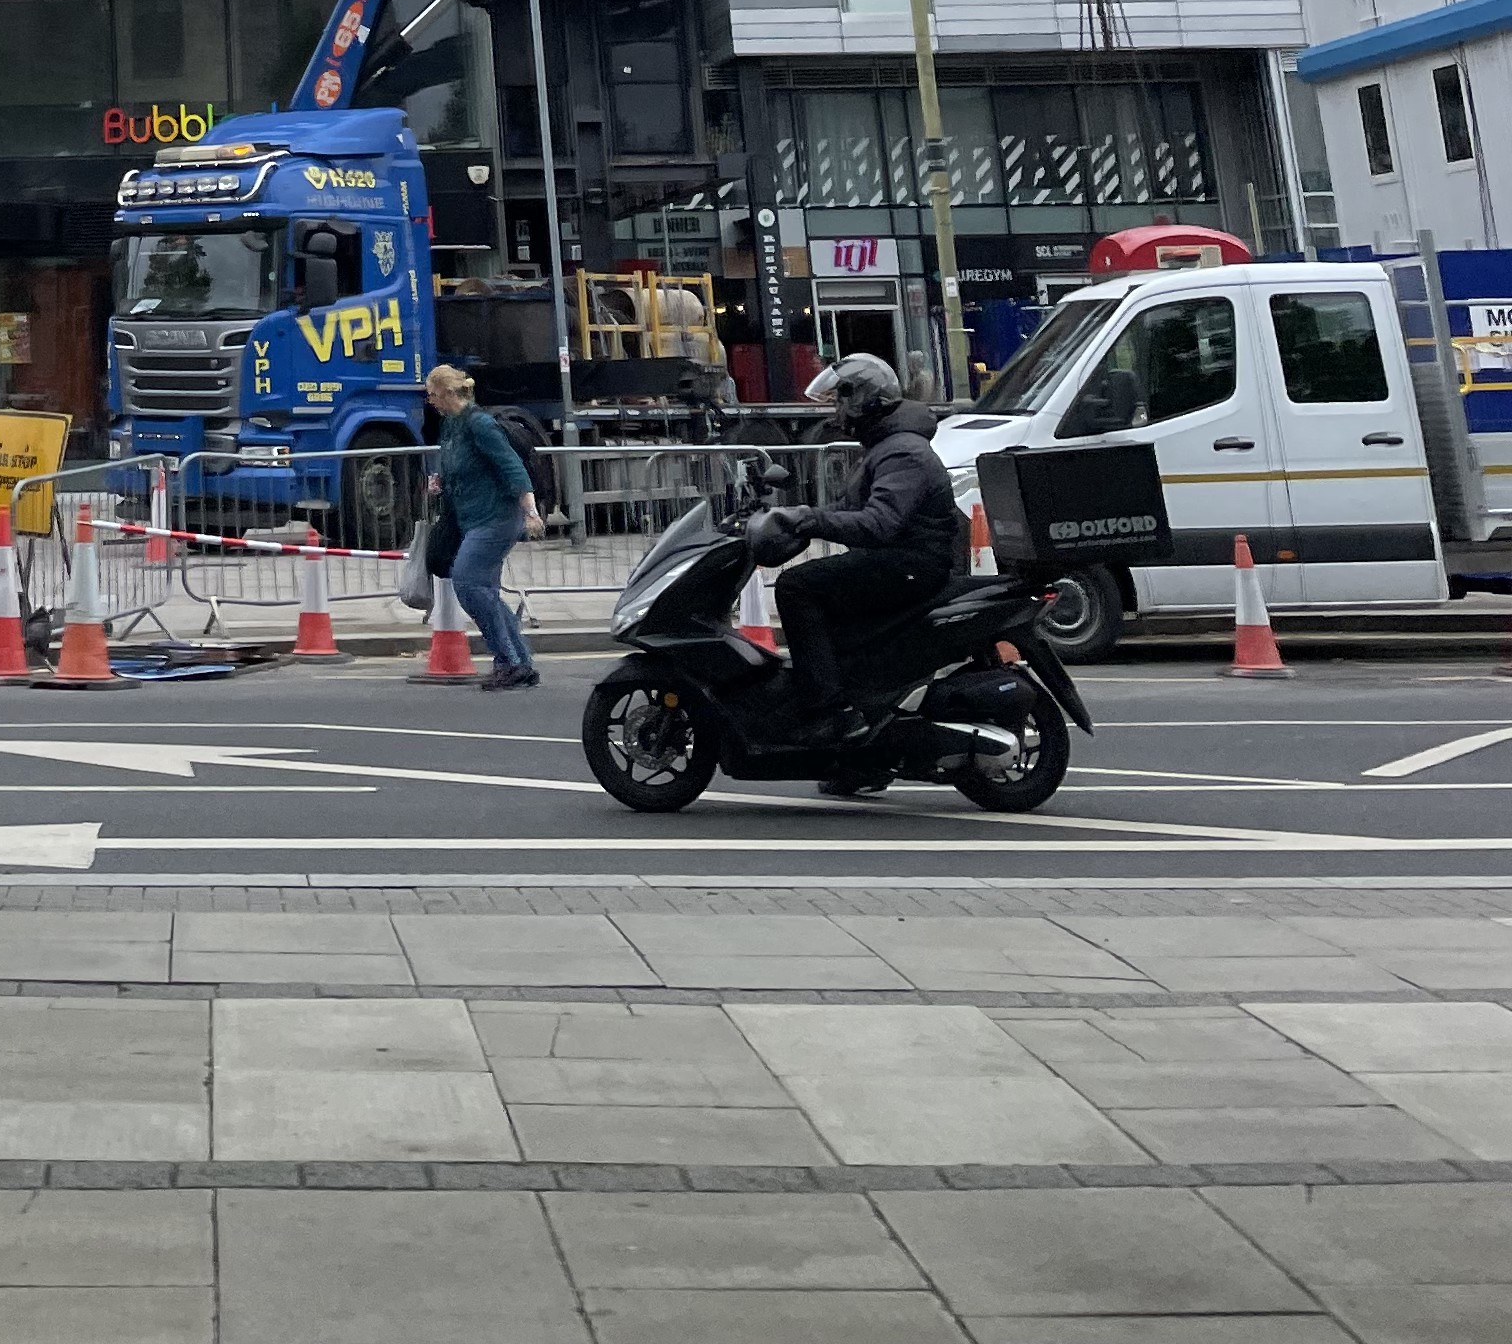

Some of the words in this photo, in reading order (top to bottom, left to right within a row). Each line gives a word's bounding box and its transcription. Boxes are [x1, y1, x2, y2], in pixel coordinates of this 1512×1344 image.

[103, 103, 215, 144] Bubbl
[956, 268, 1014, 283] UREGYM
[295, 298, 403, 363] VPH
[253, 340, 272, 395] VPH
[1080, 514, 1158, 537] OXFORD
